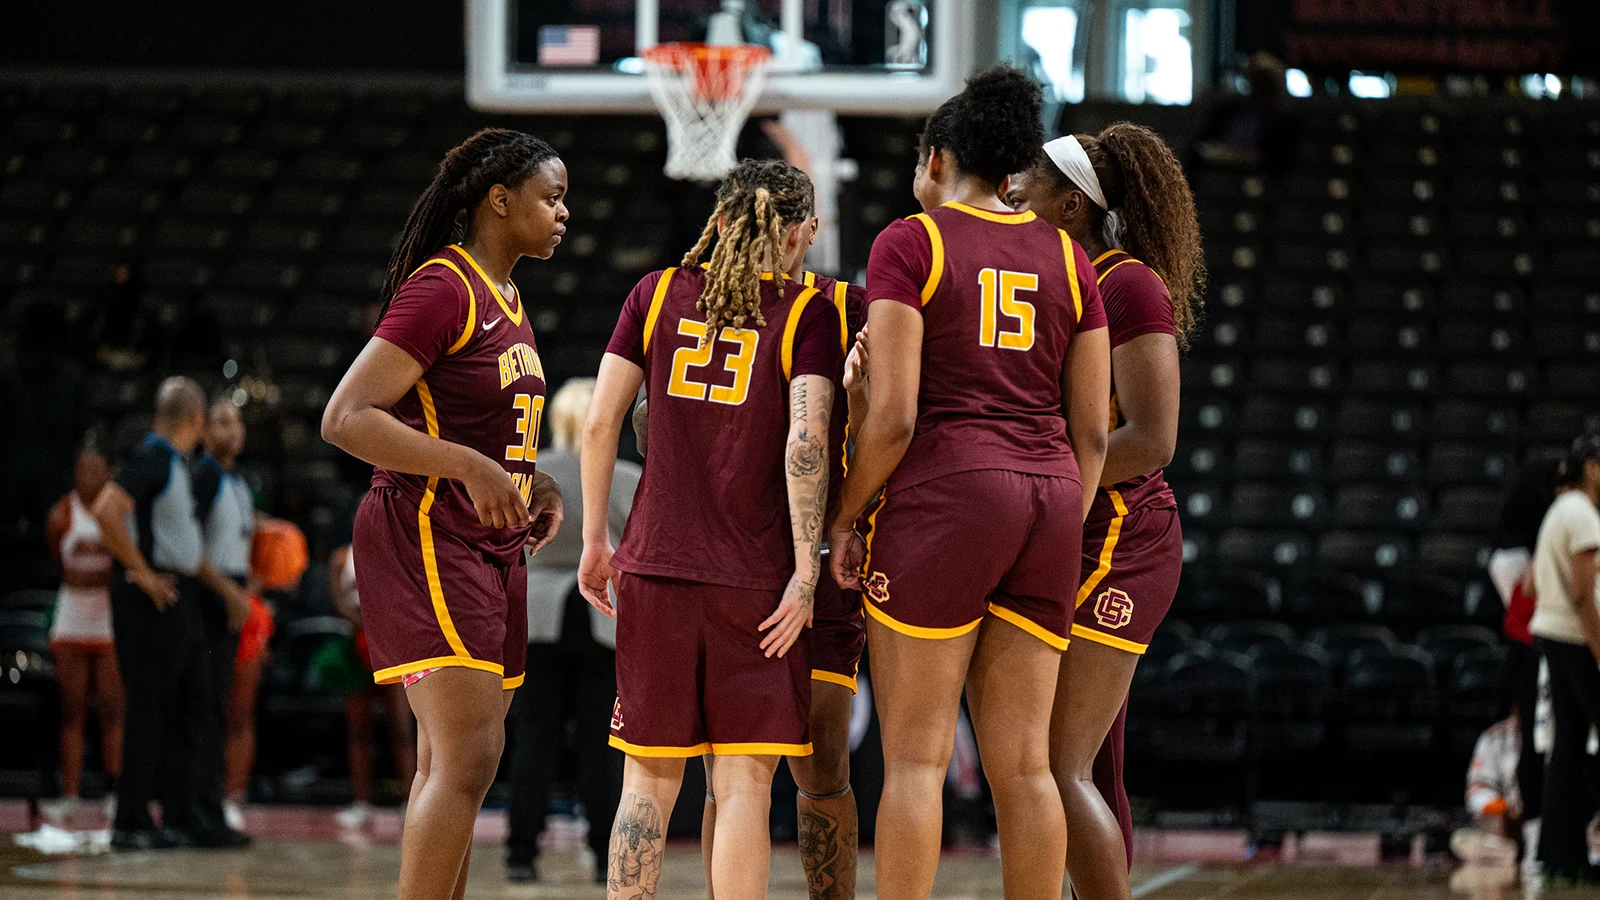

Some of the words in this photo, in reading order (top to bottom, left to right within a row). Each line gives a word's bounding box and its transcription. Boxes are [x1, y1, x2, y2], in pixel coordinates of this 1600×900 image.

[978, 267, 1039, 351] 15
[667, 318, 760, 406] 23
[505, 393, 545, 462] 30
